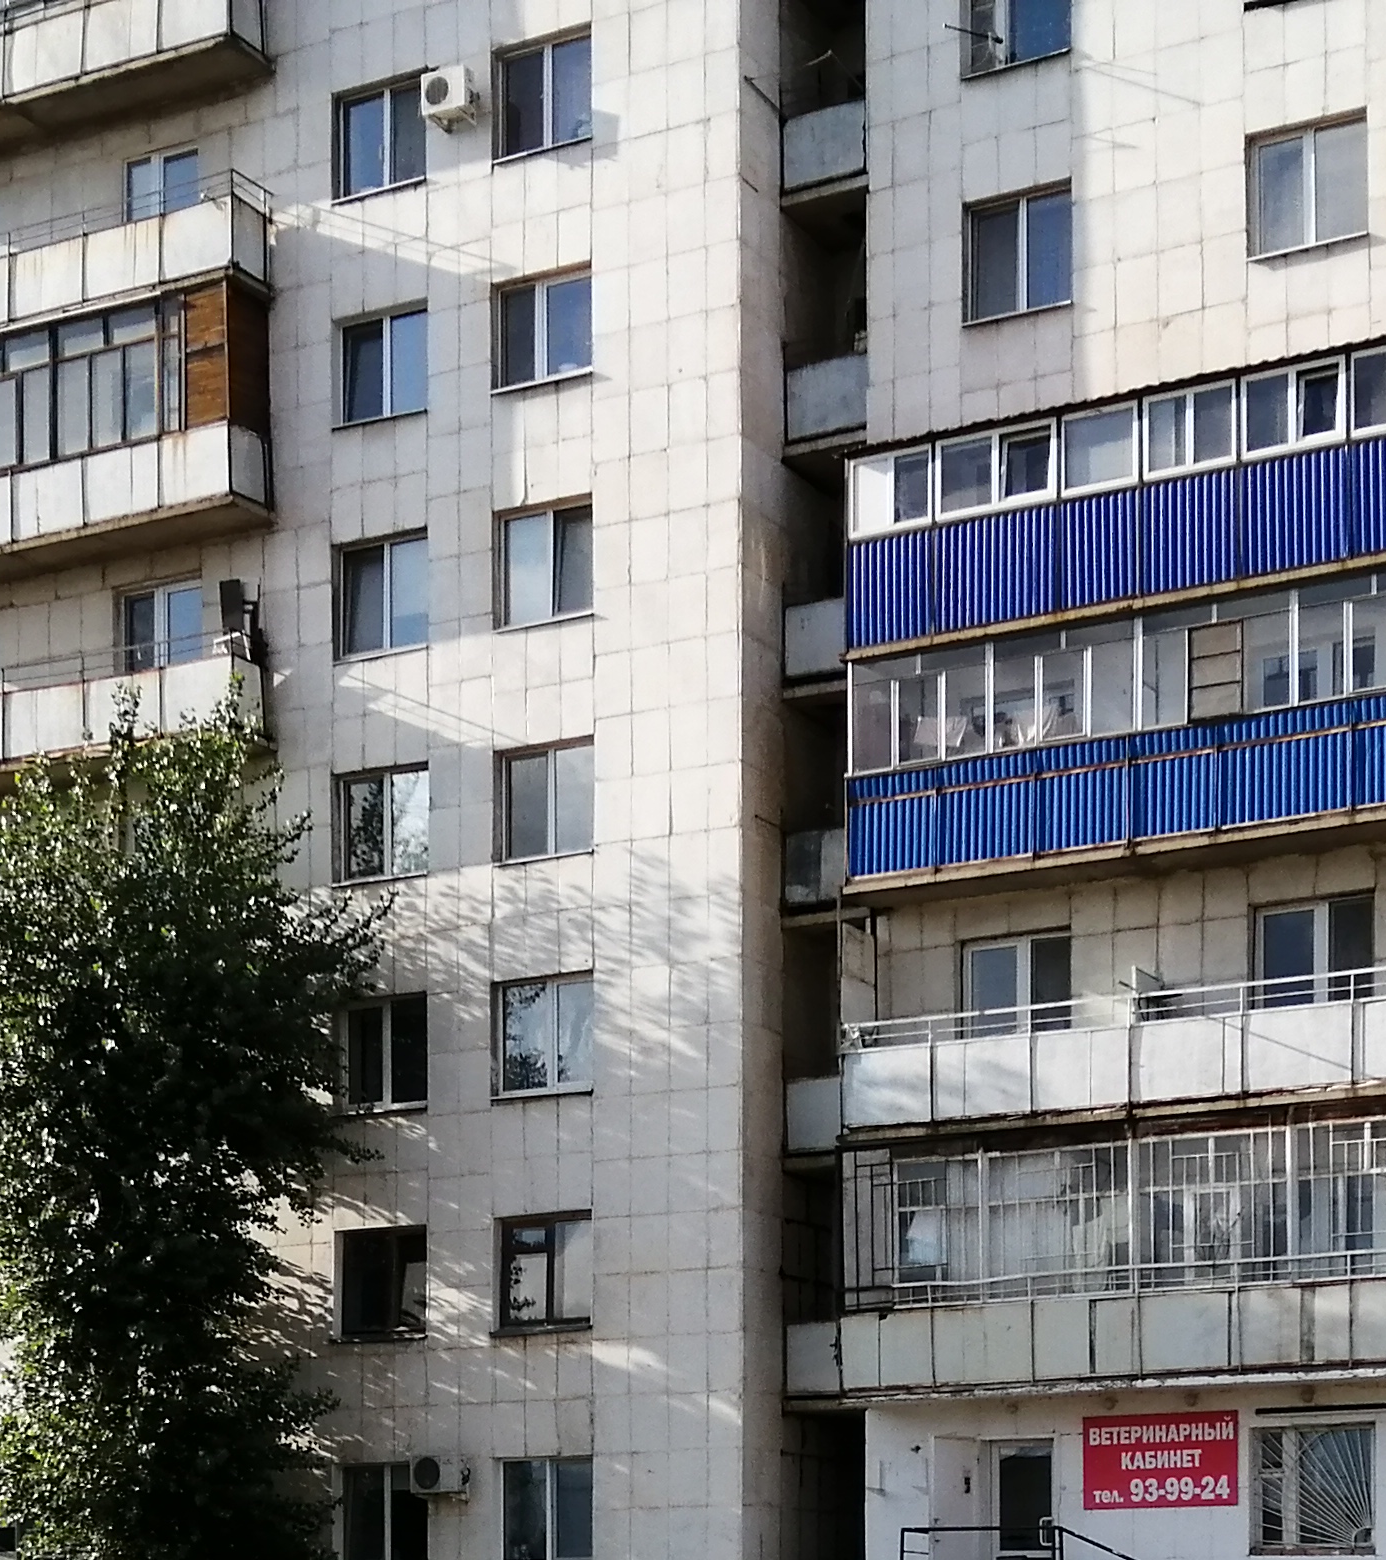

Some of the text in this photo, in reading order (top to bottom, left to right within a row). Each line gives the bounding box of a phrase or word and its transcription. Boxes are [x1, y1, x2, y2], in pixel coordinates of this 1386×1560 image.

[1089, 1416, 1234, 1446] ВЕТЕРИНАРНЫЙ
[1120, 1449, 1203, 1471] КАБИНЕТ
[1092, 1474, 1230, 1504] тел. 93-99-24
